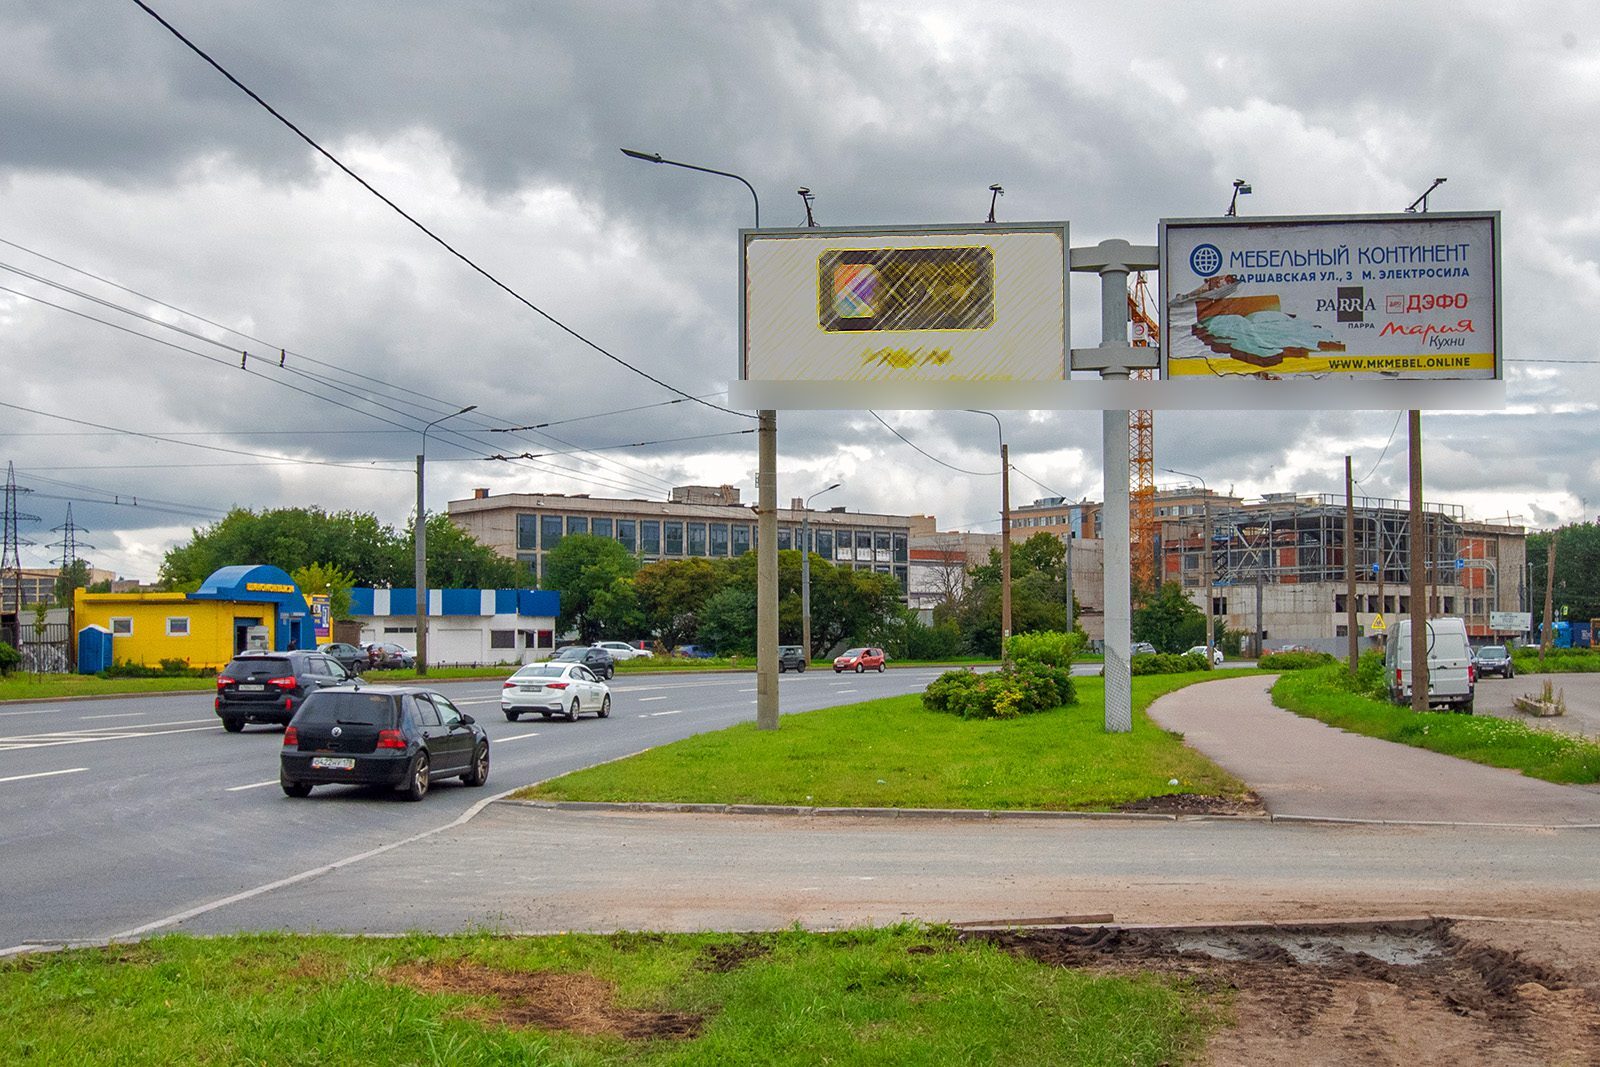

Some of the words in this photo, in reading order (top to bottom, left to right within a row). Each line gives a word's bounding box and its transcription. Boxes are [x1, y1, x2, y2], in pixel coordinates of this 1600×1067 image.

[1229, 244, 1350, 269] МЕБЕЛЬНЫЙ
[1358, 243, 1470, 265] КОНТИНЕНТ
[1346, 271, 1353, 281] 3
[1362, 270, 1376, 281] М.
[1379, 267, 1470, 280] ЭЛЕКТРОСИЛА
[1316, 296, 1377, 314] PARRA
[1406, 292, 1469, 313] ДЭФО
[1347, 321, 1376, 329] ПАРРА
[1429, 335, 1466, 350] Кухни
[1328, 356, 1471, 369] WWW.MKMEBEL.ONLINE
